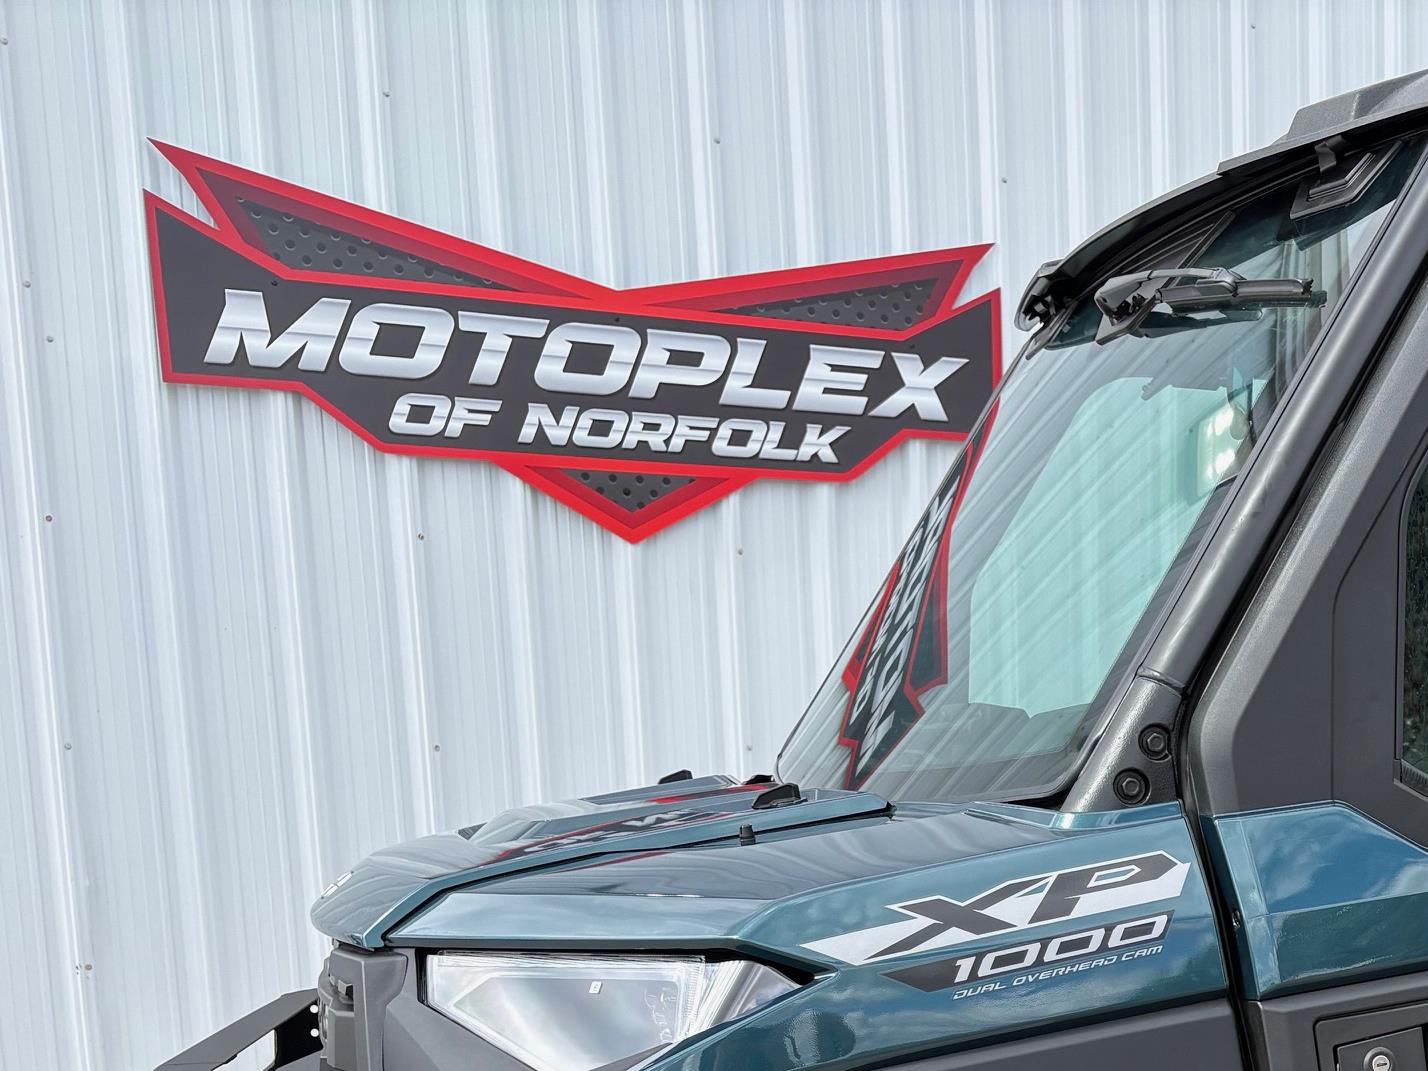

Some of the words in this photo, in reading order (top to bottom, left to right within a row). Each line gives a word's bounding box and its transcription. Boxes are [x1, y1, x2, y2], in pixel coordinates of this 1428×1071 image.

[203, 287, 971, 422] MOTOPLEX
[388, 393, 504, 438] OF
[518, 402, 853, 465] NORFOLK
[863, 850, 1182, 961] XP
[952, 980, 1006, 1001] DUAL
[1012, 955, 1118, 987] OVERHEAD
[1121, 944, 1164, 962] CAM
[954, 914, 1169, 984] 1000
